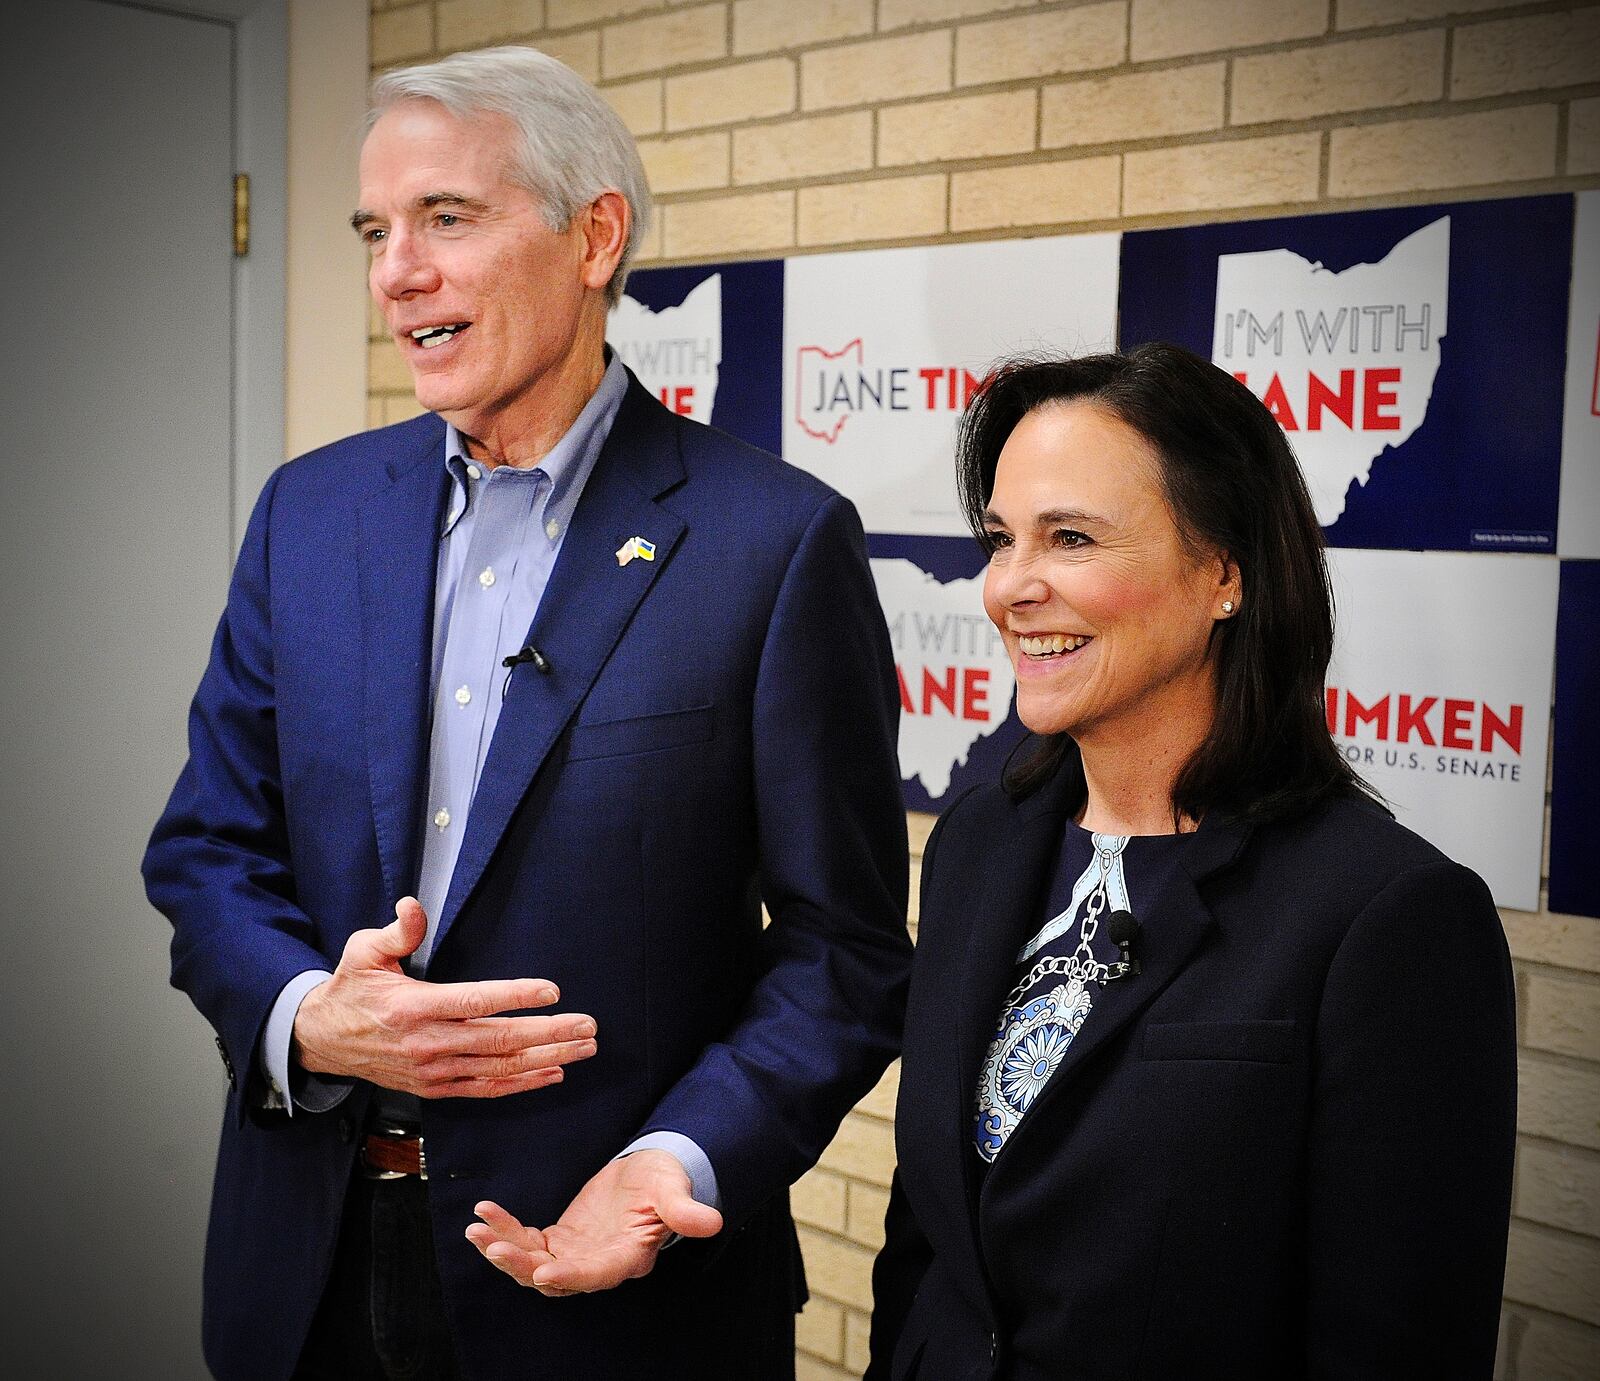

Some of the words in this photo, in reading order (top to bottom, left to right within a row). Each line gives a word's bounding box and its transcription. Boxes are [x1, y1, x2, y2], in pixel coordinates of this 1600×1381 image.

[1224, 308, 1284, 358] I'M
[1296, 303, 1431, 355] WITH
[631, 337, 713, 377] WITH
[814, 368, 909, 412] JANE
[1233, 368, 1401, 431] ANE
[1325, 687, 1524, 757] IMKEN
[1336, 744, 1375, 764] OR
[1385, 749, 1426, 771] U.S.
[1436, 755, 1521, 782] SENATE
